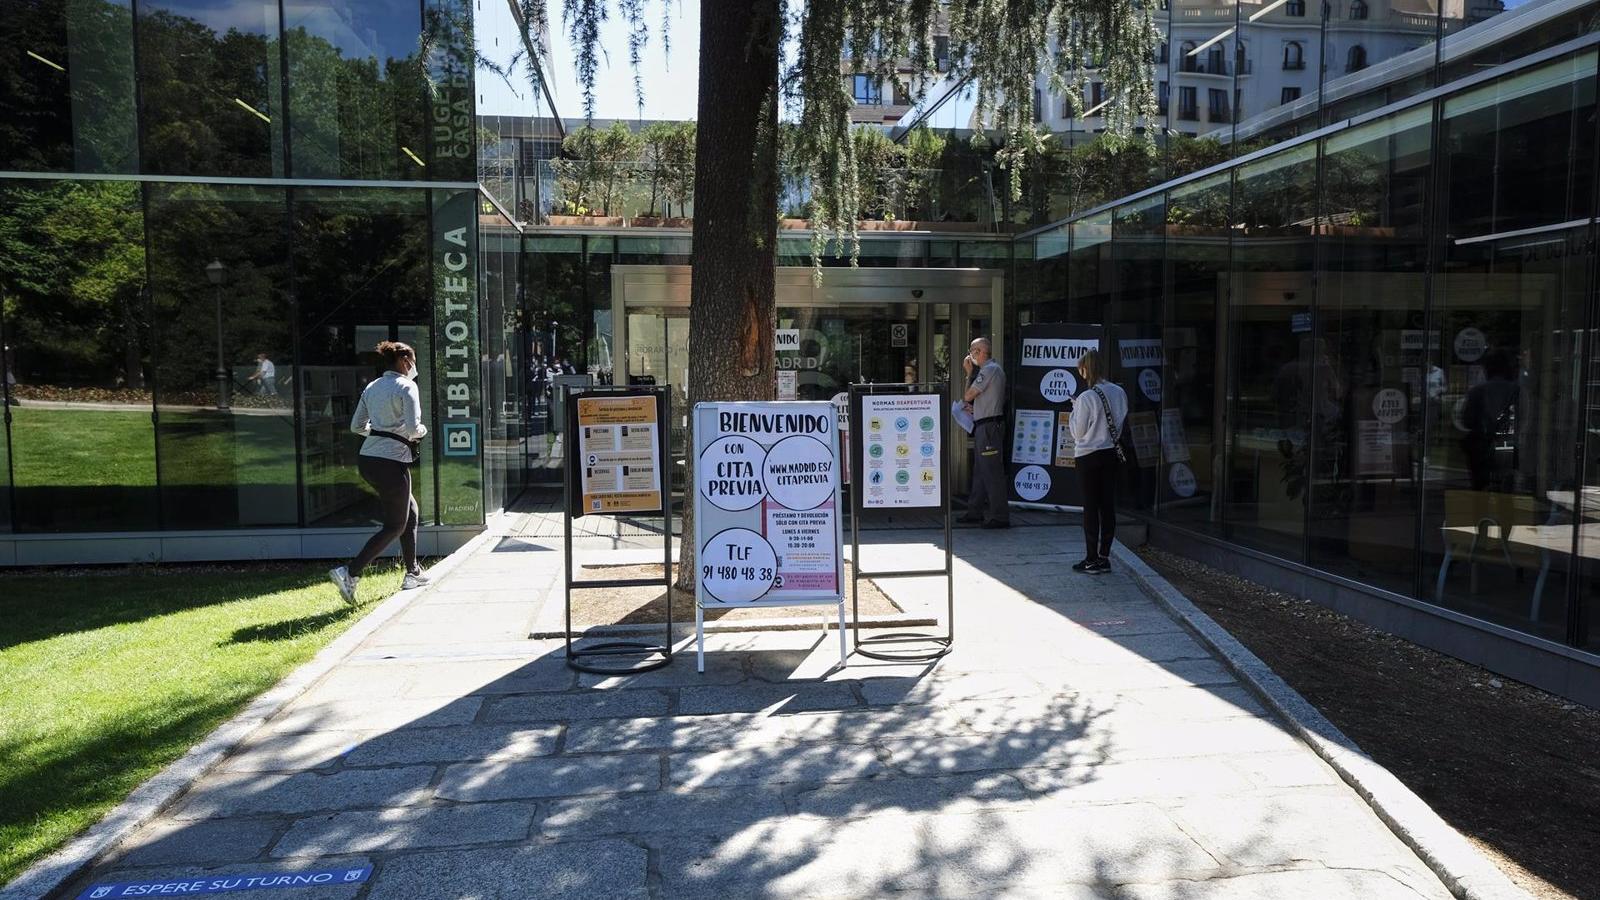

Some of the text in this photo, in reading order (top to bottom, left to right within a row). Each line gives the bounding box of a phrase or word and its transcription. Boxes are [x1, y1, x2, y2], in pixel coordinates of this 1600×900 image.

[452, 98, 471, 159] CASA
[444, 226, 471, 448] BIBLIOTECA
[1049, 380, 1068, 388] CITA
[720, 411, 829, 434] BIENVENIDO
[724, 443, 744, 454] CON
[717, 461, 754, 478] CITA
[770, 460, 832, 474] WWW.MADRID.ES/
[708, 479, 762, 496] PREVIA
[777, 474, 829, 485] CITAPREVIA
[726, 543, 753, 561] TLF
[703, 565, 713, 580] 91
[718, 565, 737, 580] 480
[741, 567, 754, 580] 48
[759, 568, 772, 581] 38
[121, 873, 333, 895] ESPERE SU TURNO
